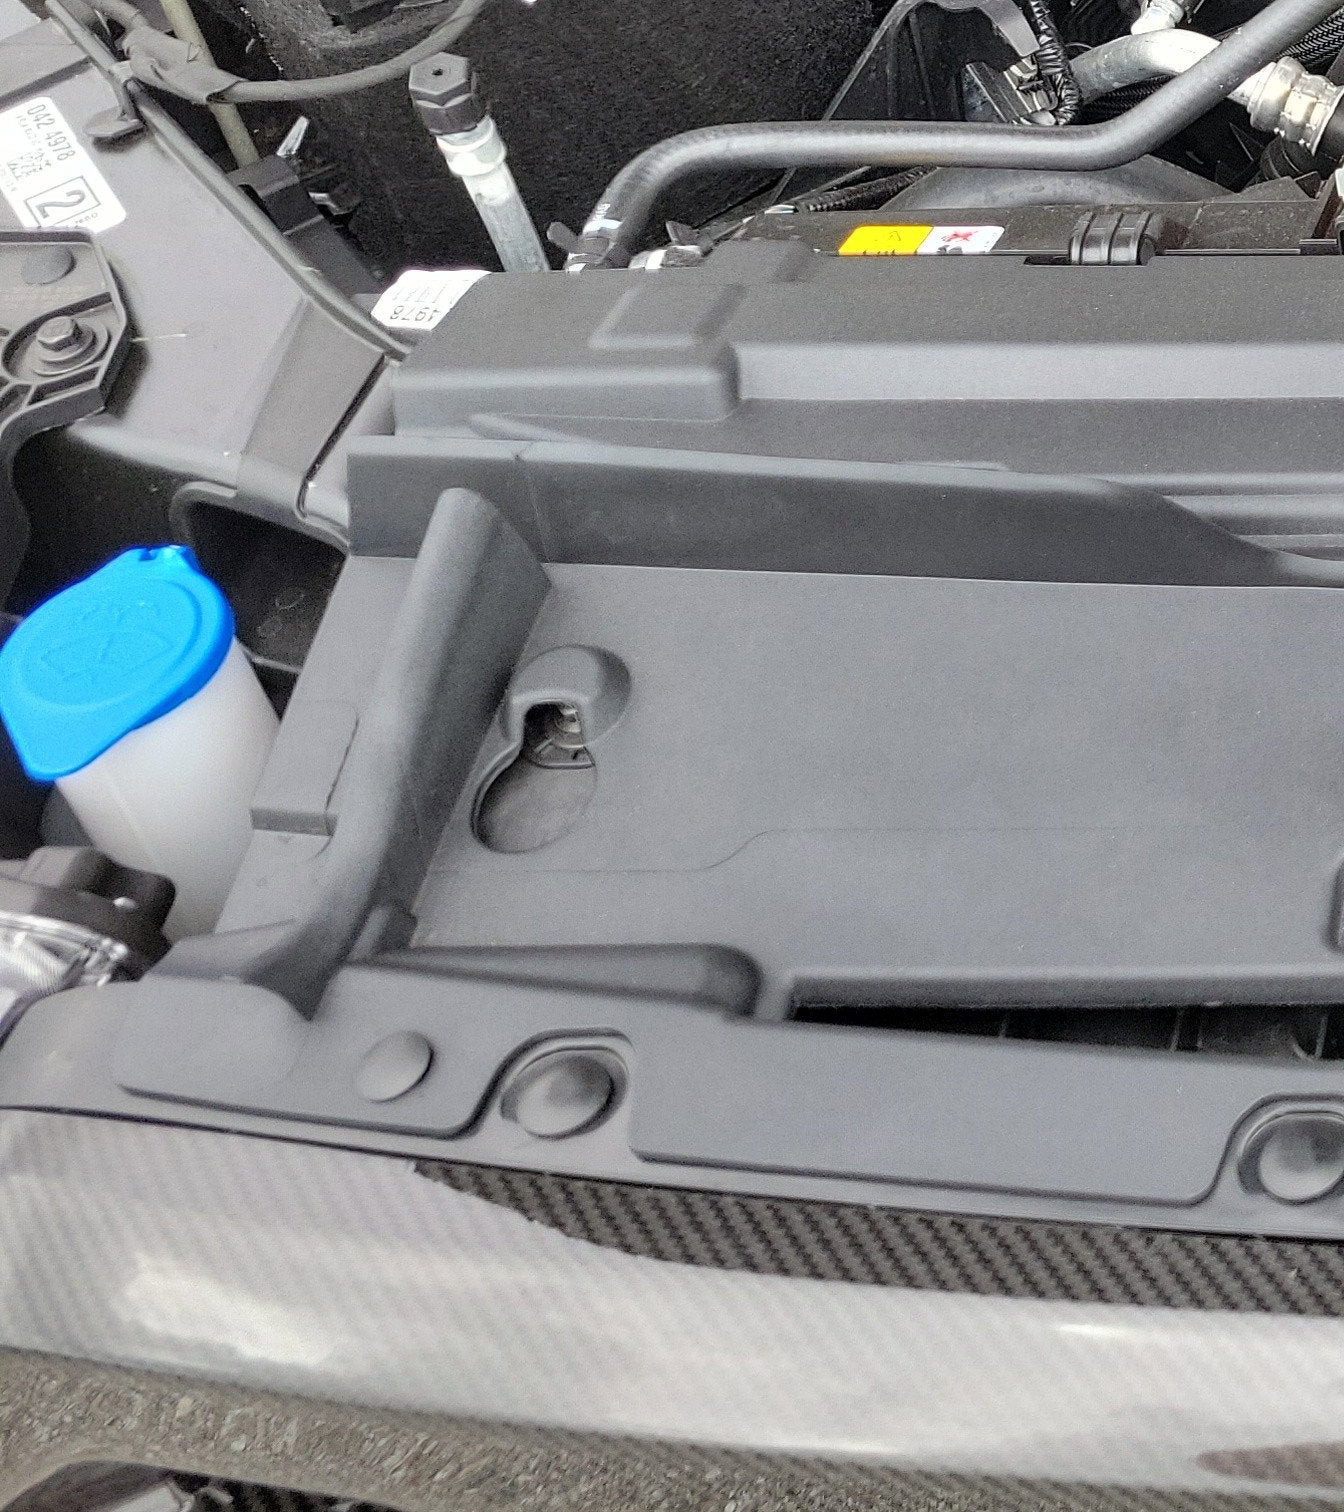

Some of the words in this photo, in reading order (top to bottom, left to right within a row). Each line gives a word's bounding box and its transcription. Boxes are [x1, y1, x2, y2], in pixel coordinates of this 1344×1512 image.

[27, 104, 55, 130] 042
[46, 129, 77, 162] 4978
[35, 189, 86, 220] 2
